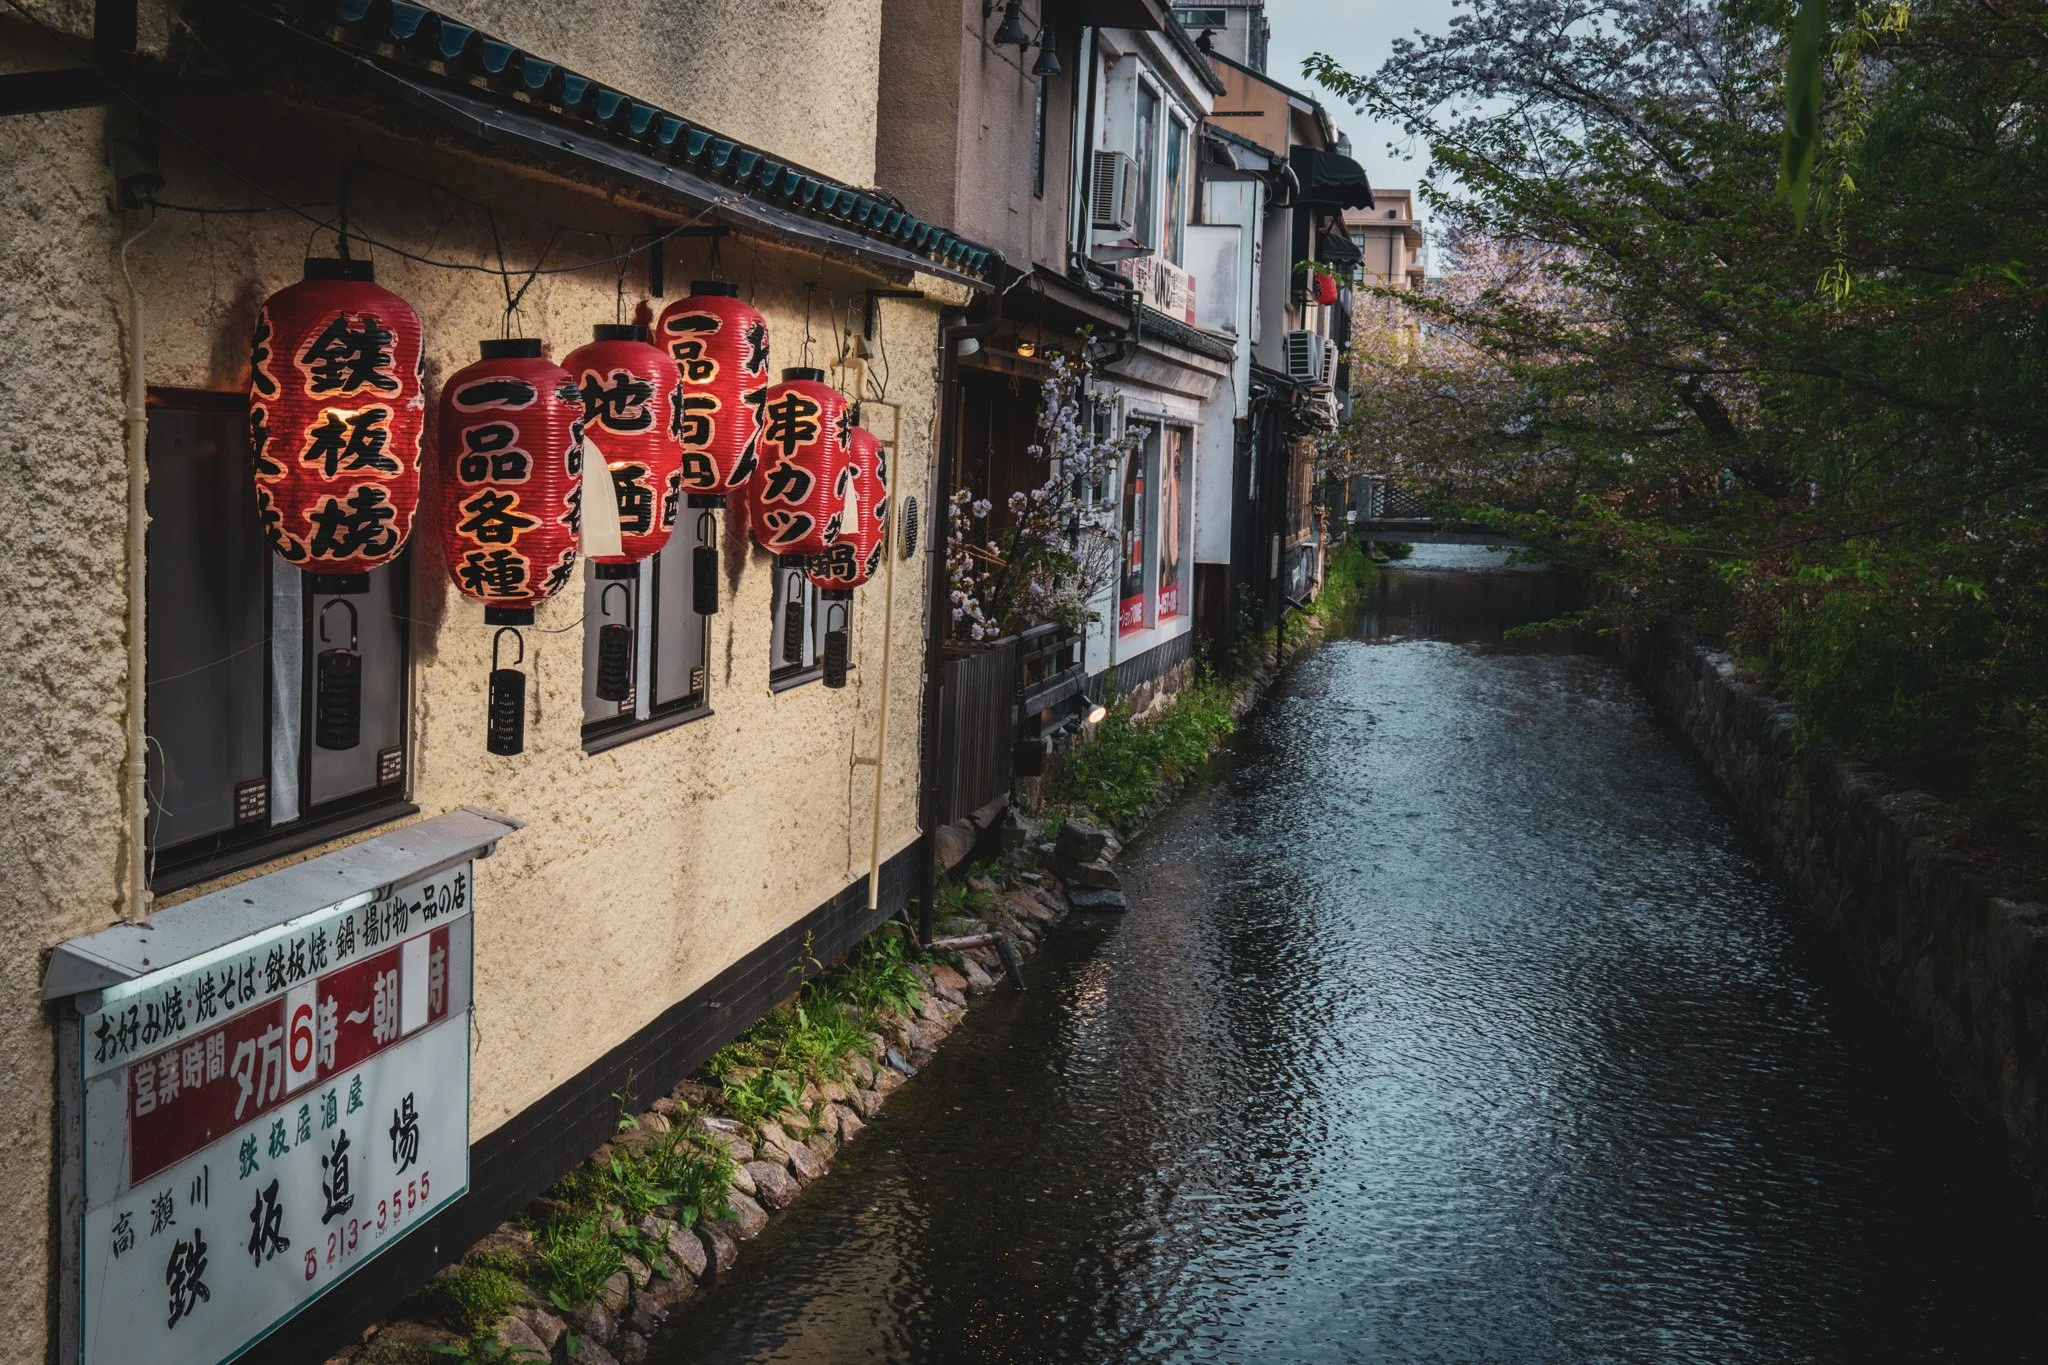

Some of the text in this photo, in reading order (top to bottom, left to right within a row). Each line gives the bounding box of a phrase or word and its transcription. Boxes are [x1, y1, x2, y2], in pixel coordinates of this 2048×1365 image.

[301, 316, 402, 557] 鉄板焼
[455, 379, 540, 597] 一品各種
[763, 392, 823, 545] 串カツ
[135, 1031, 225, 1117] 営業時間
[239, 1073, 364, 1181] 鉄板居酒屋
[111, 1164, 208, 1260] 高瀬川
[165, 1091, 419, 1331] 鉄板道場
